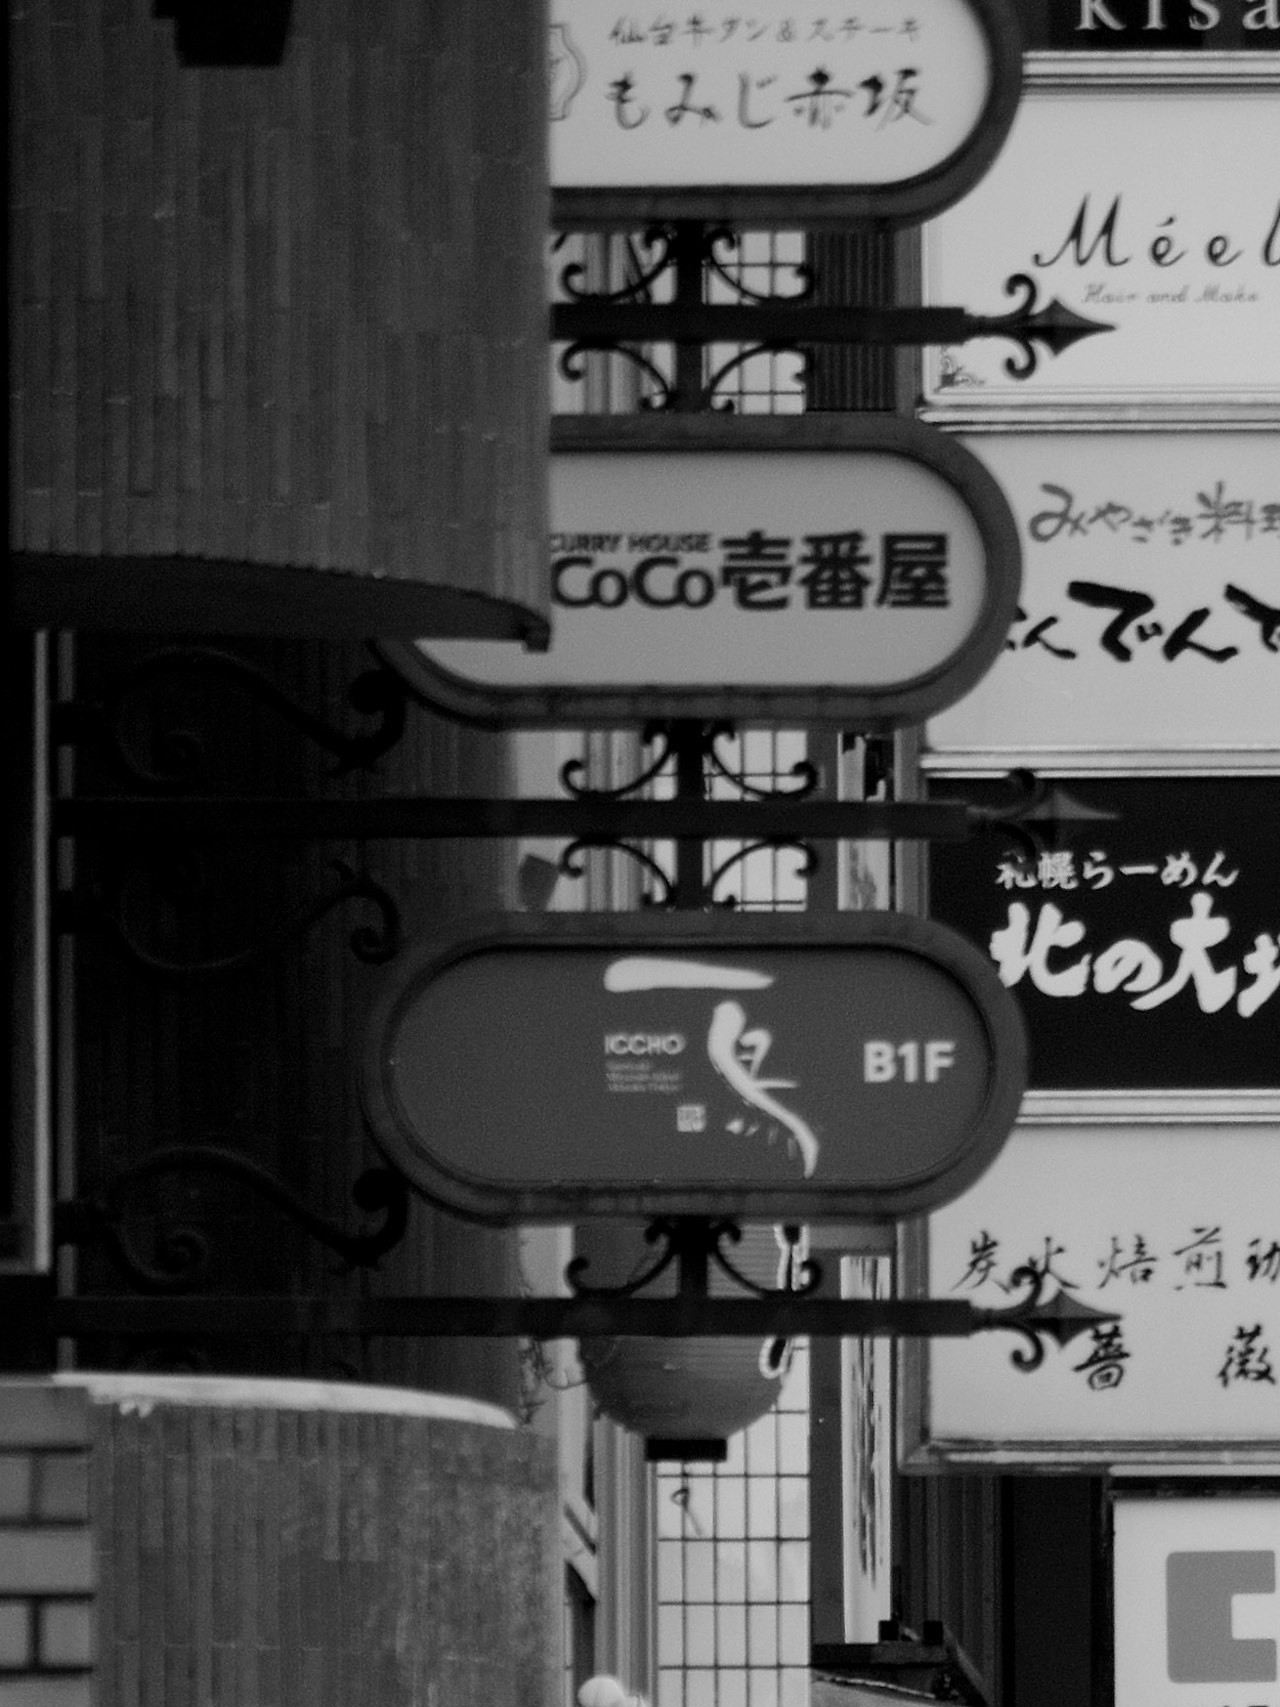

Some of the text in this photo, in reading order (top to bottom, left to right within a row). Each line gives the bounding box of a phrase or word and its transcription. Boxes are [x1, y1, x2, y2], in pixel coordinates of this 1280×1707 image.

[606, 66, 933, 130] もみじ赤坂
[627, 532, 712, 554] HOUSE
[994, 849, 1240, 890] 札幌らーめん
[604, 1032, 687, 1055] ICCHO
[863, 1039, 956, 1083] B1F
